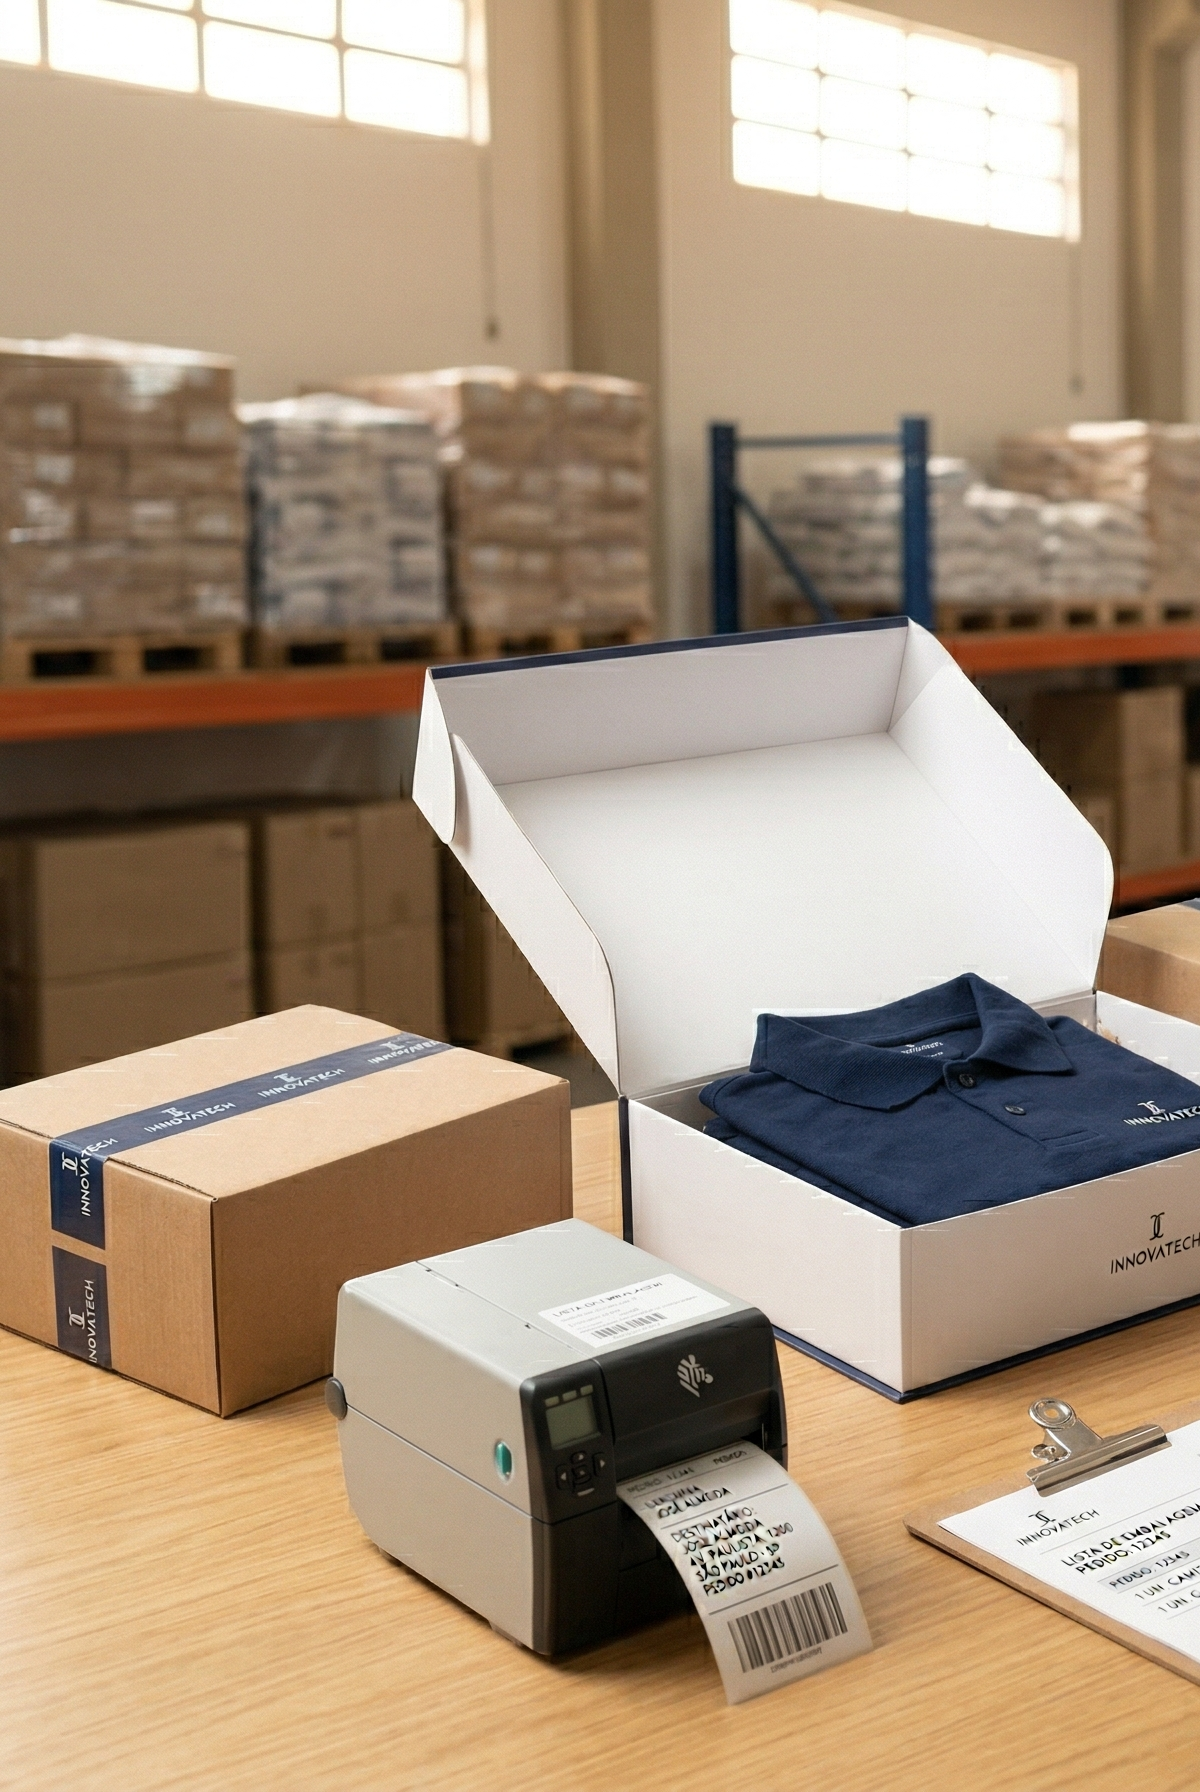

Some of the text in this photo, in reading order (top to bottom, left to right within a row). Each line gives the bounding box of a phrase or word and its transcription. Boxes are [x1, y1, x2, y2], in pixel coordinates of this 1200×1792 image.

[257, 1068, 346, 1098] INNOVATECH
[143, 1101, 237, 1133] INNOVATECH
[80, 1137, 118, 1217] INNOVATECH
[1016, 1508, 1101, 1547] INNOVATECH
